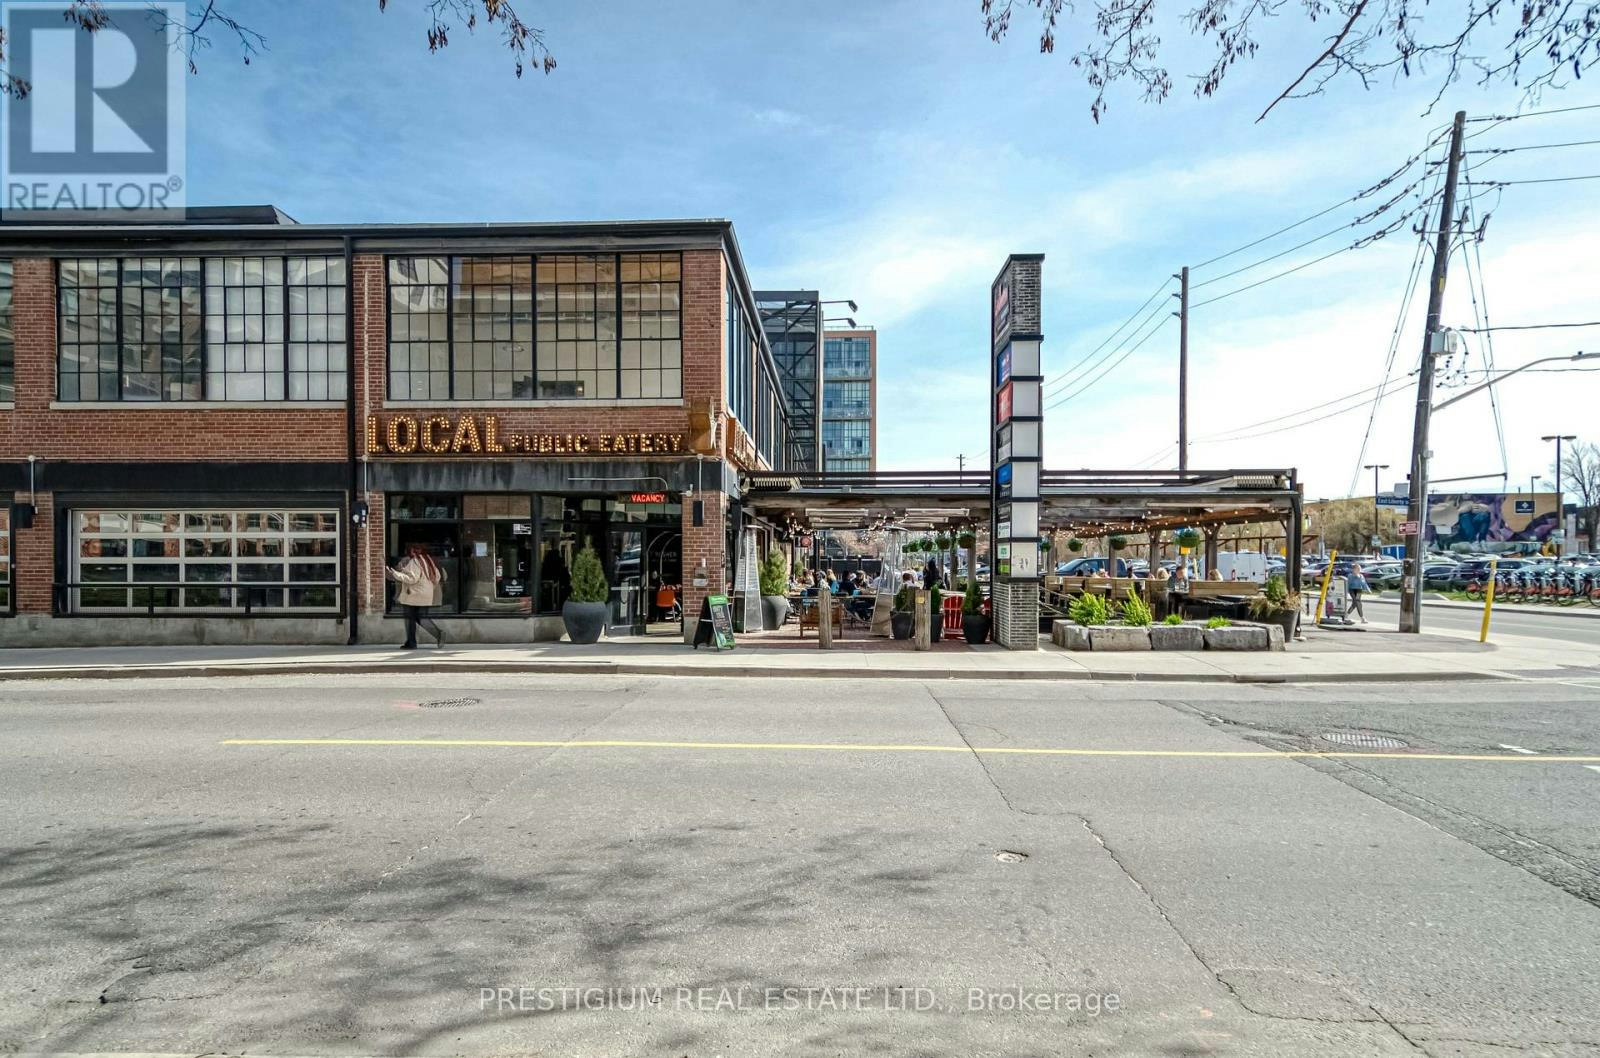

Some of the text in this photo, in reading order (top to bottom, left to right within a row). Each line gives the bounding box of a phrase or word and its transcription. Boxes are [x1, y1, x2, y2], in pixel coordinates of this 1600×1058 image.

[367, 414, 683, 454] LOCAL PUBLIC EATERY
[631, 493, 665, 503] VACANCY
